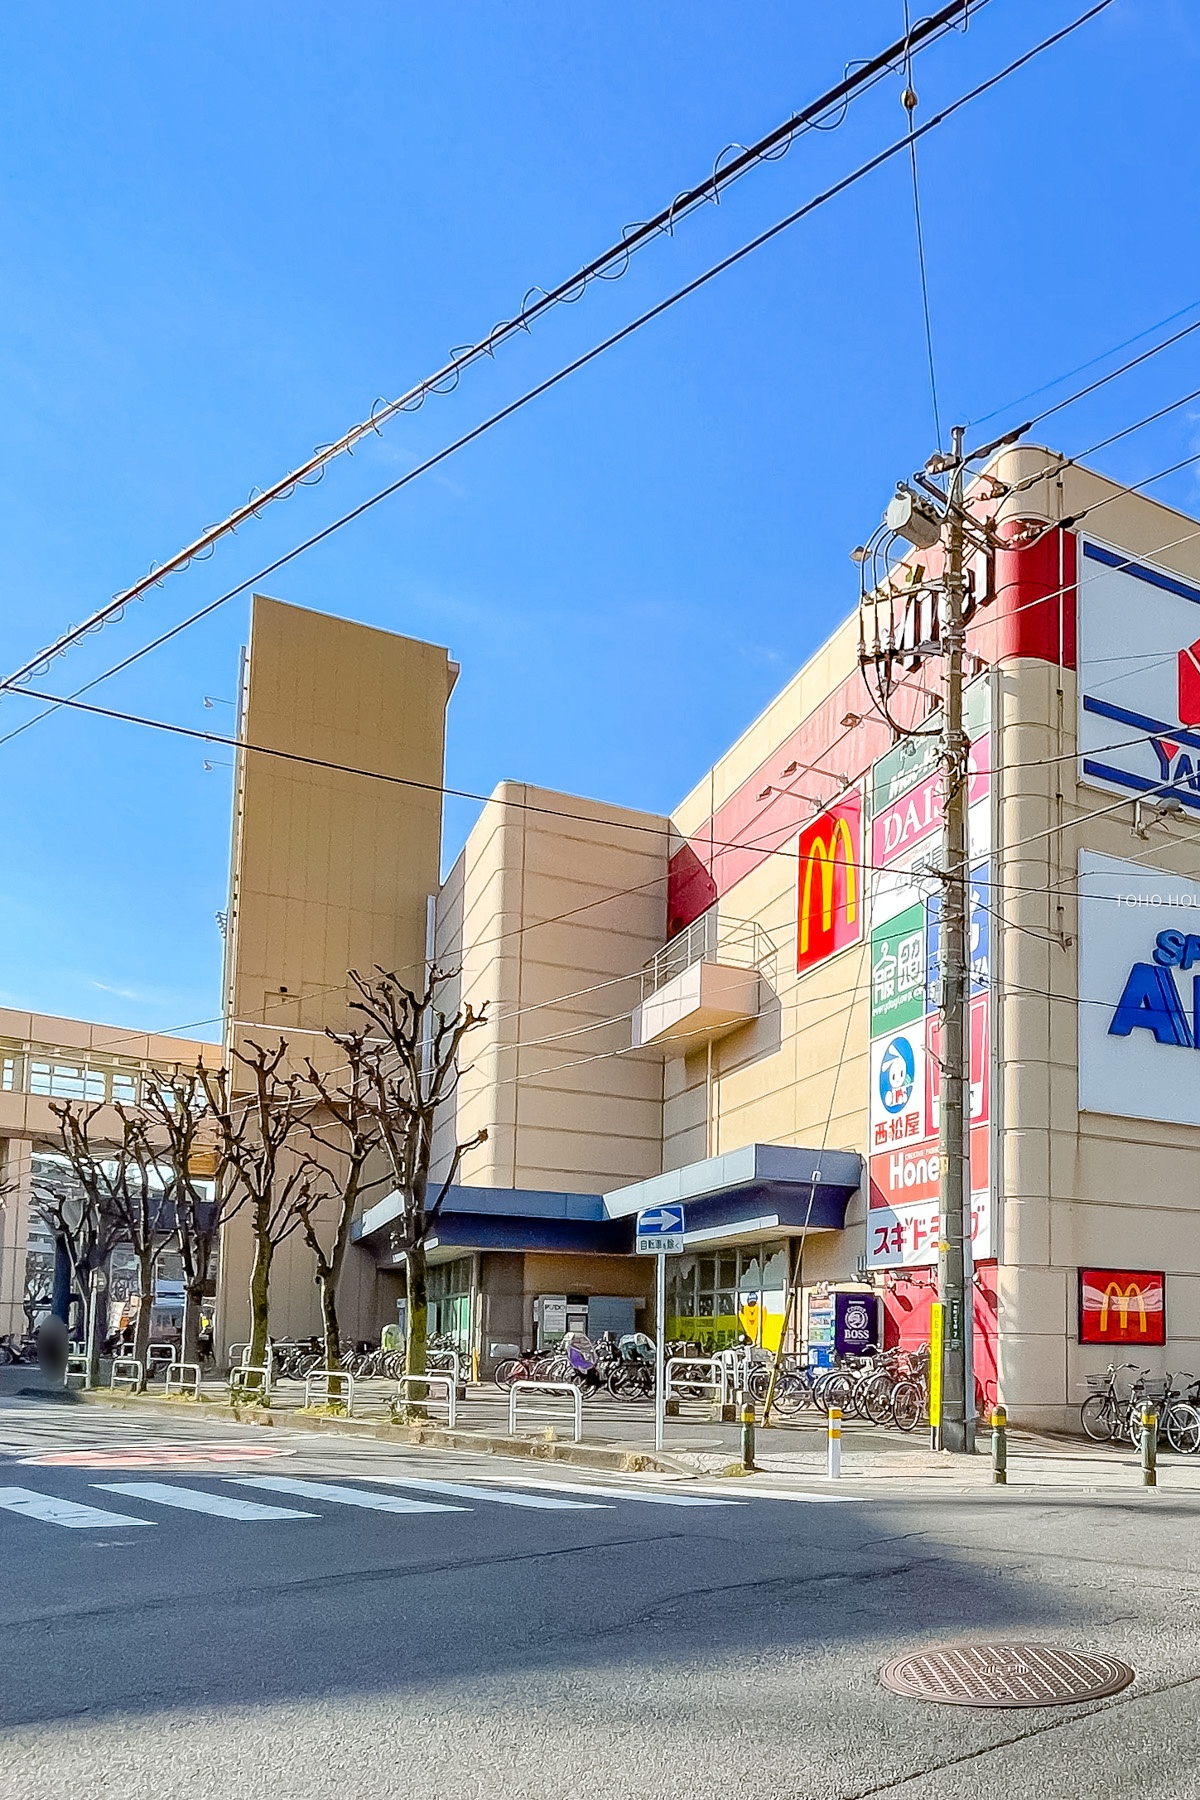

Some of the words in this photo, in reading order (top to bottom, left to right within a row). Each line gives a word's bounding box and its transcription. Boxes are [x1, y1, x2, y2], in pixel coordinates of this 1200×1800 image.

[874, 1111, 920, 1146] 西松屋
[889, 1151, 940, 1191] Hone
[873, 1205, 985, 1256] スギドグ
[844, 1329, 870, 1339] BOSS
